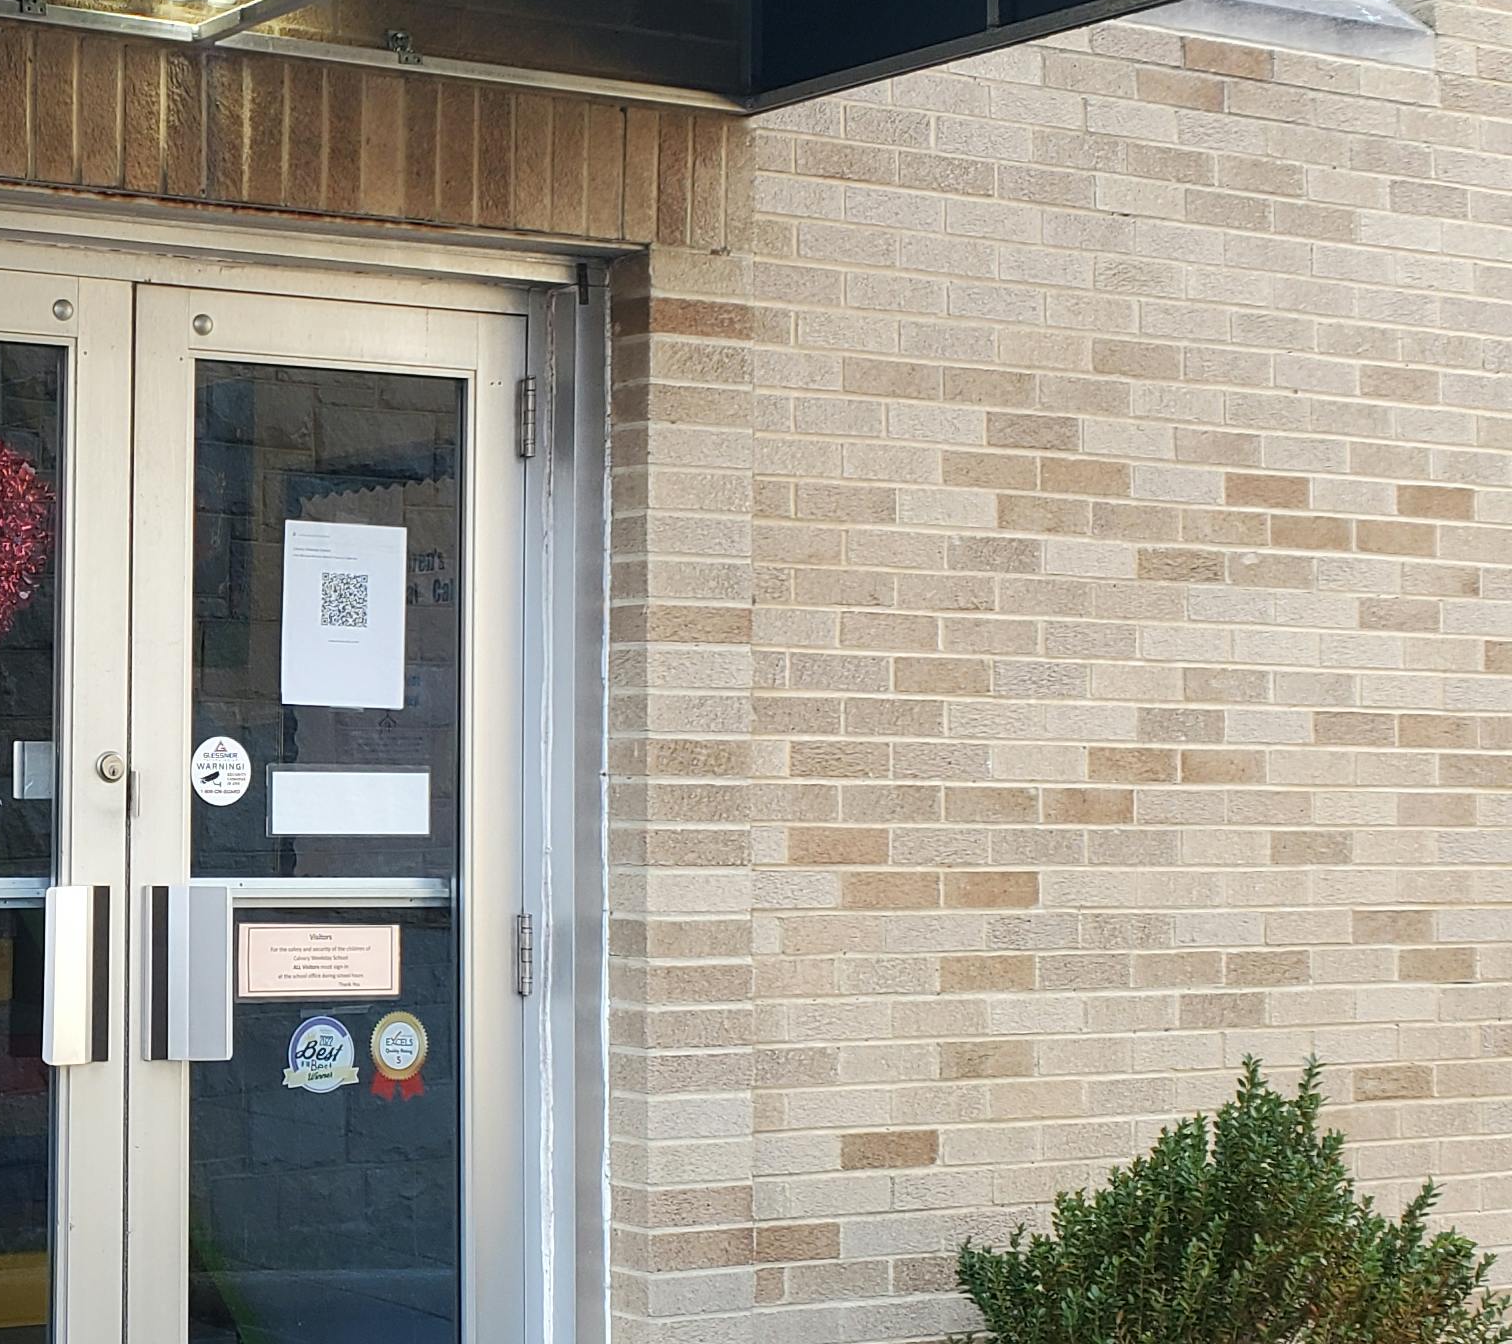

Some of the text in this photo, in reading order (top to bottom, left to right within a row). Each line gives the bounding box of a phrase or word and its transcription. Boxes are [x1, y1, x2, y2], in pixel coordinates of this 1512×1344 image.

[196, 762, 245, 770] WARNING!
[385, 1034, 413, 1046] EXCELS
[295, 1040, 343, 1062] Best
[396, 1055, 402, 1064] 5
